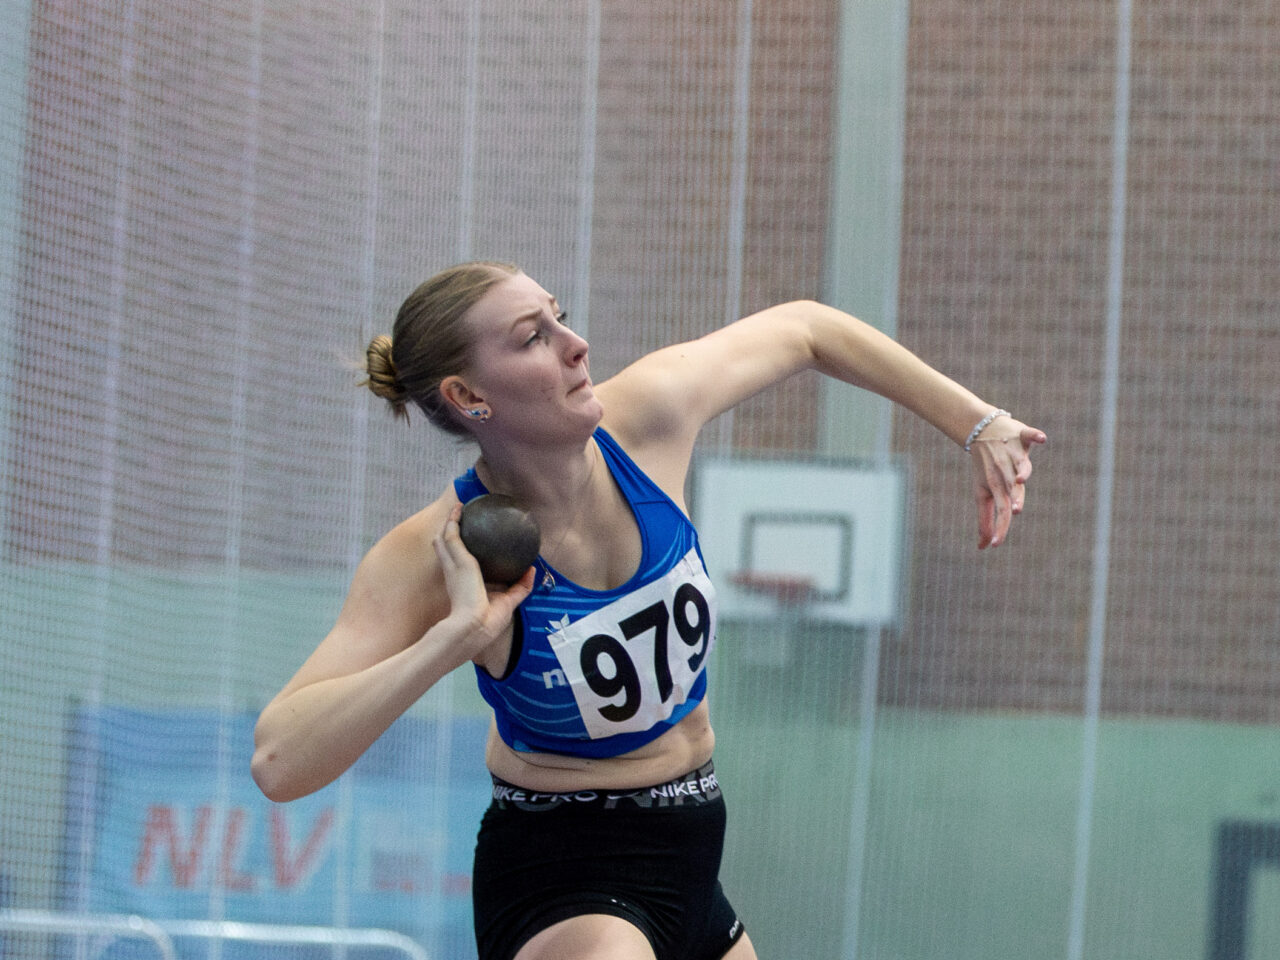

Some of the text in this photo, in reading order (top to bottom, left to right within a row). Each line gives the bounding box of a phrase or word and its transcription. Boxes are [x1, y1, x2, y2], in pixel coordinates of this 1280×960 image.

[580, 583, 711, 722] 979
[650, 780, 700, 799] NIKE
[134, 804, 336, 889] NLV
